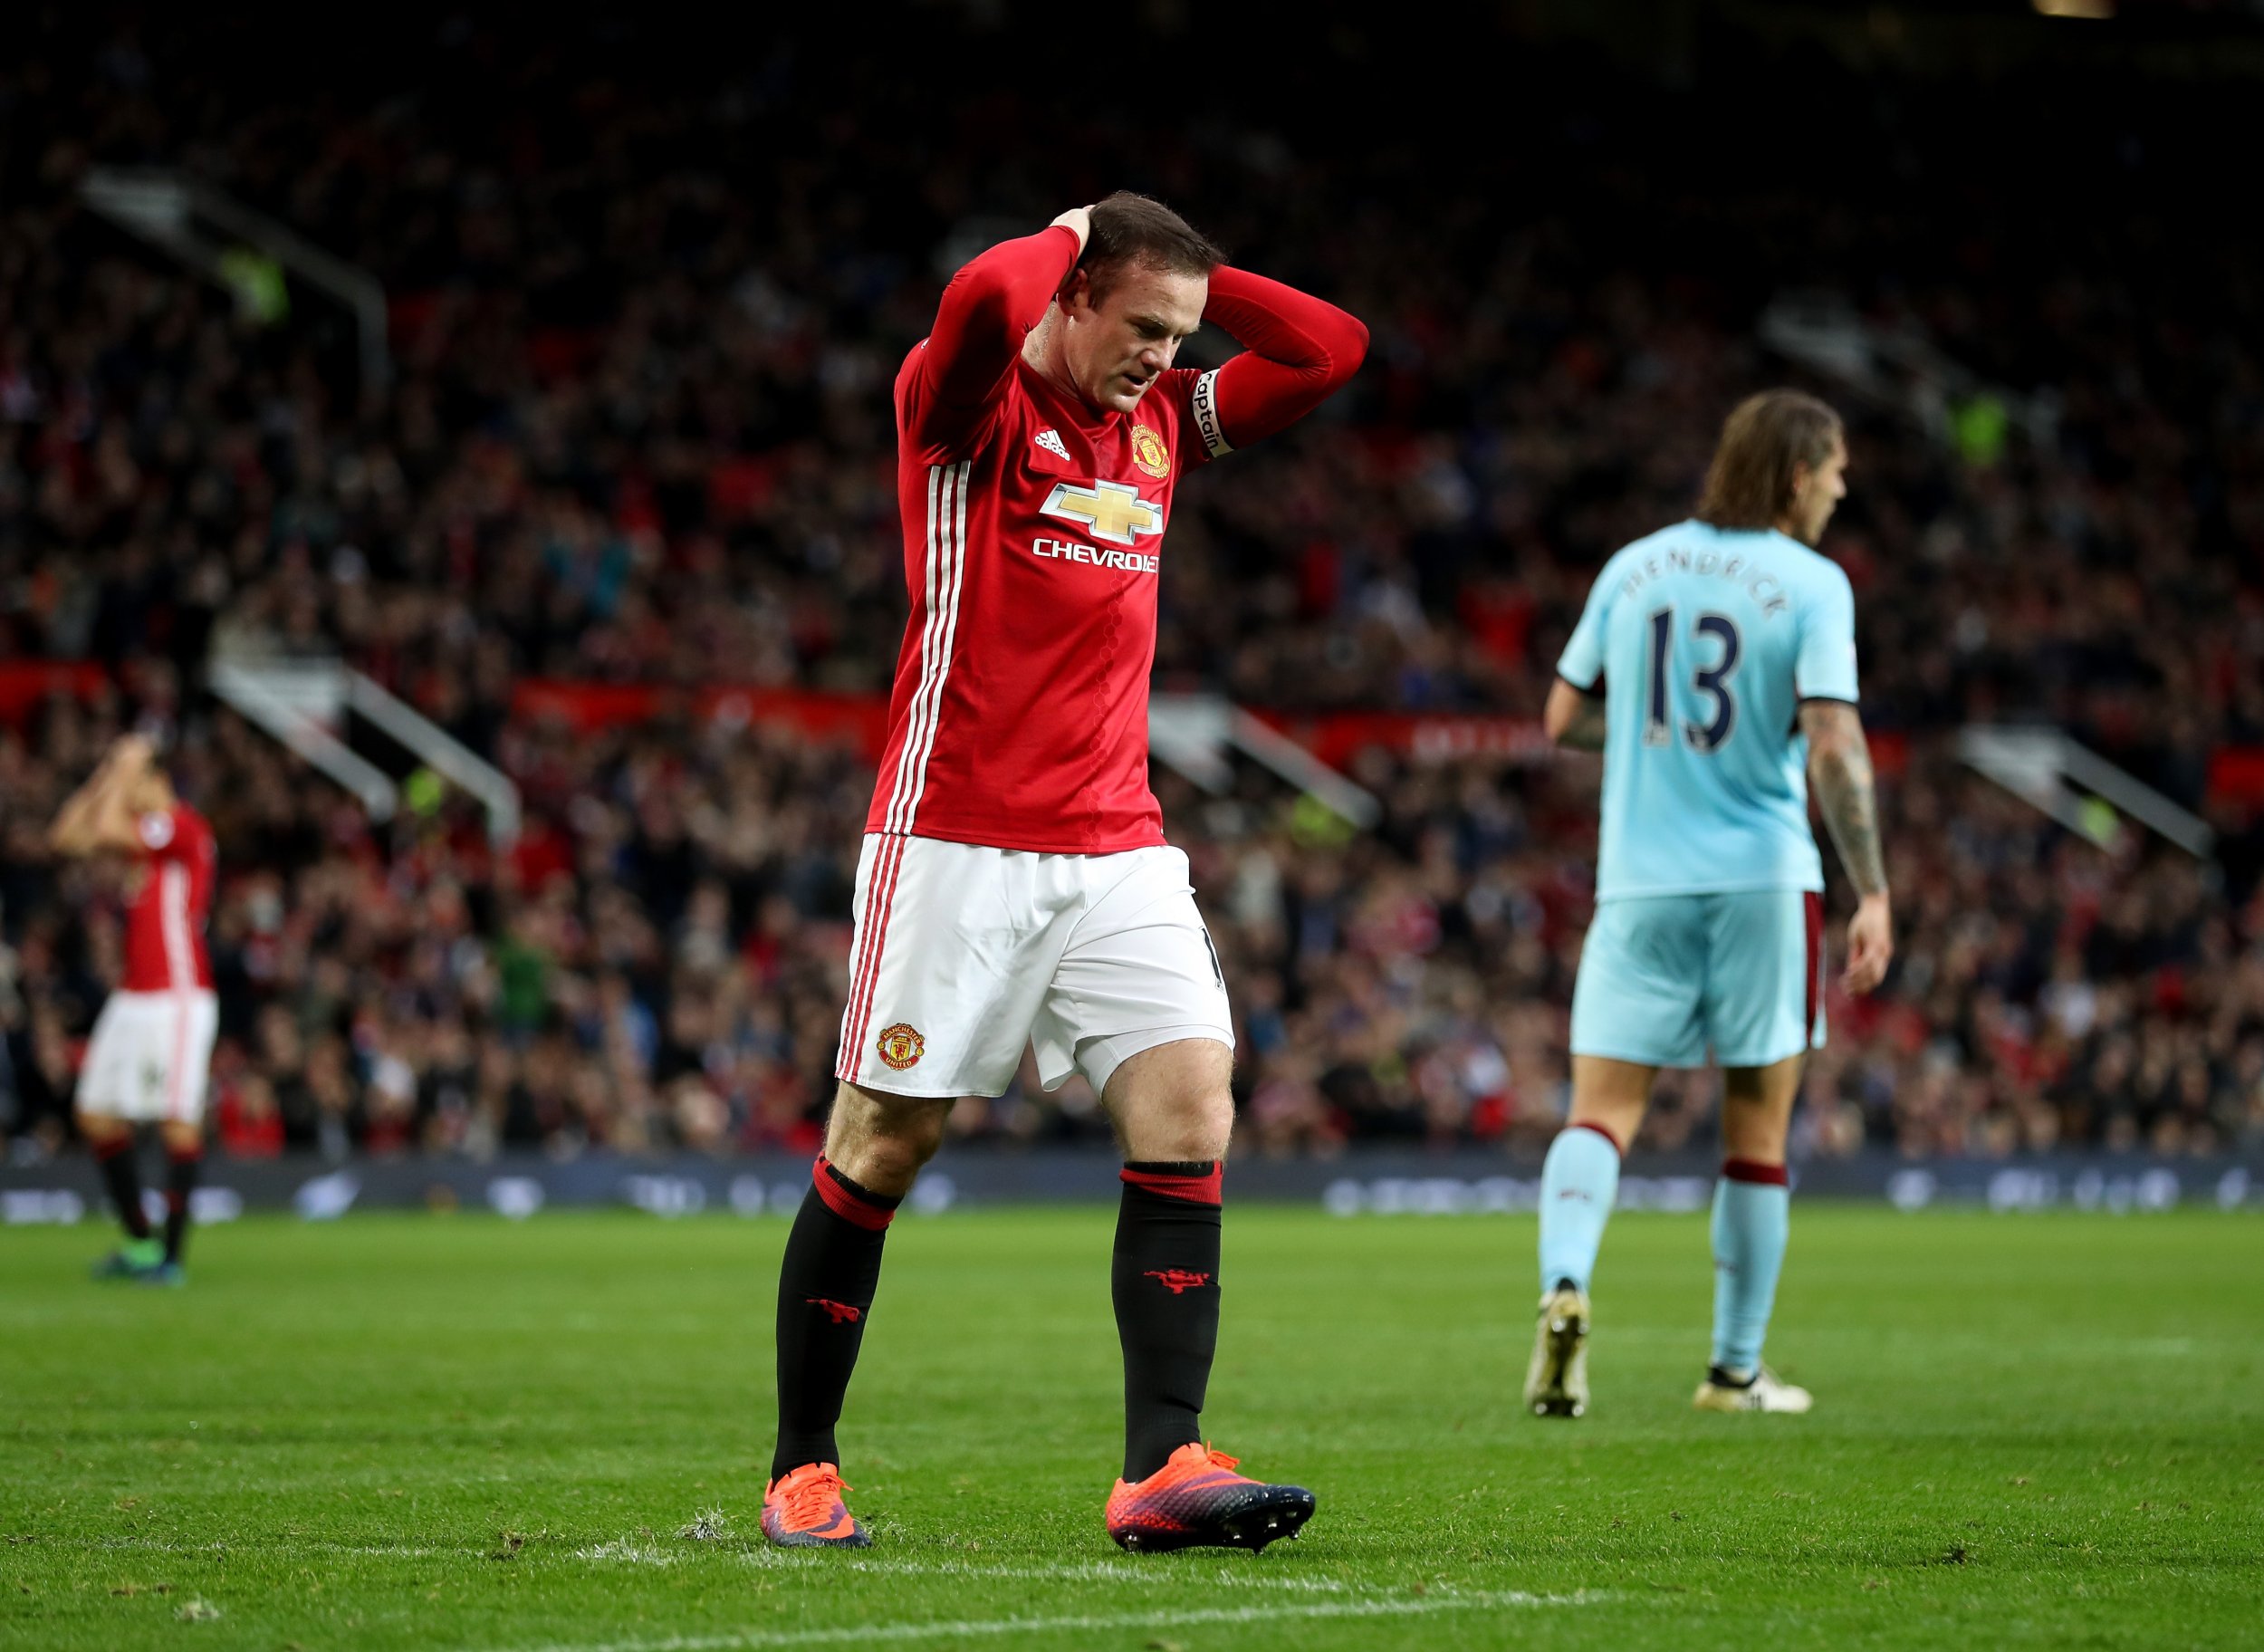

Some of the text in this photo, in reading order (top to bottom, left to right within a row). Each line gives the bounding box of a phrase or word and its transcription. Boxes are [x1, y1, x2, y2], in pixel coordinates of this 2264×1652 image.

[1034, 436, 1071, 462] adidas
[1623, 546, 1788, 623] HENDRICK
[1643, 601, 1741, 753] 13
[883, 1026, 922, 1045] MANCHESTER
[885, 1057, 913, 1068] UNITED
